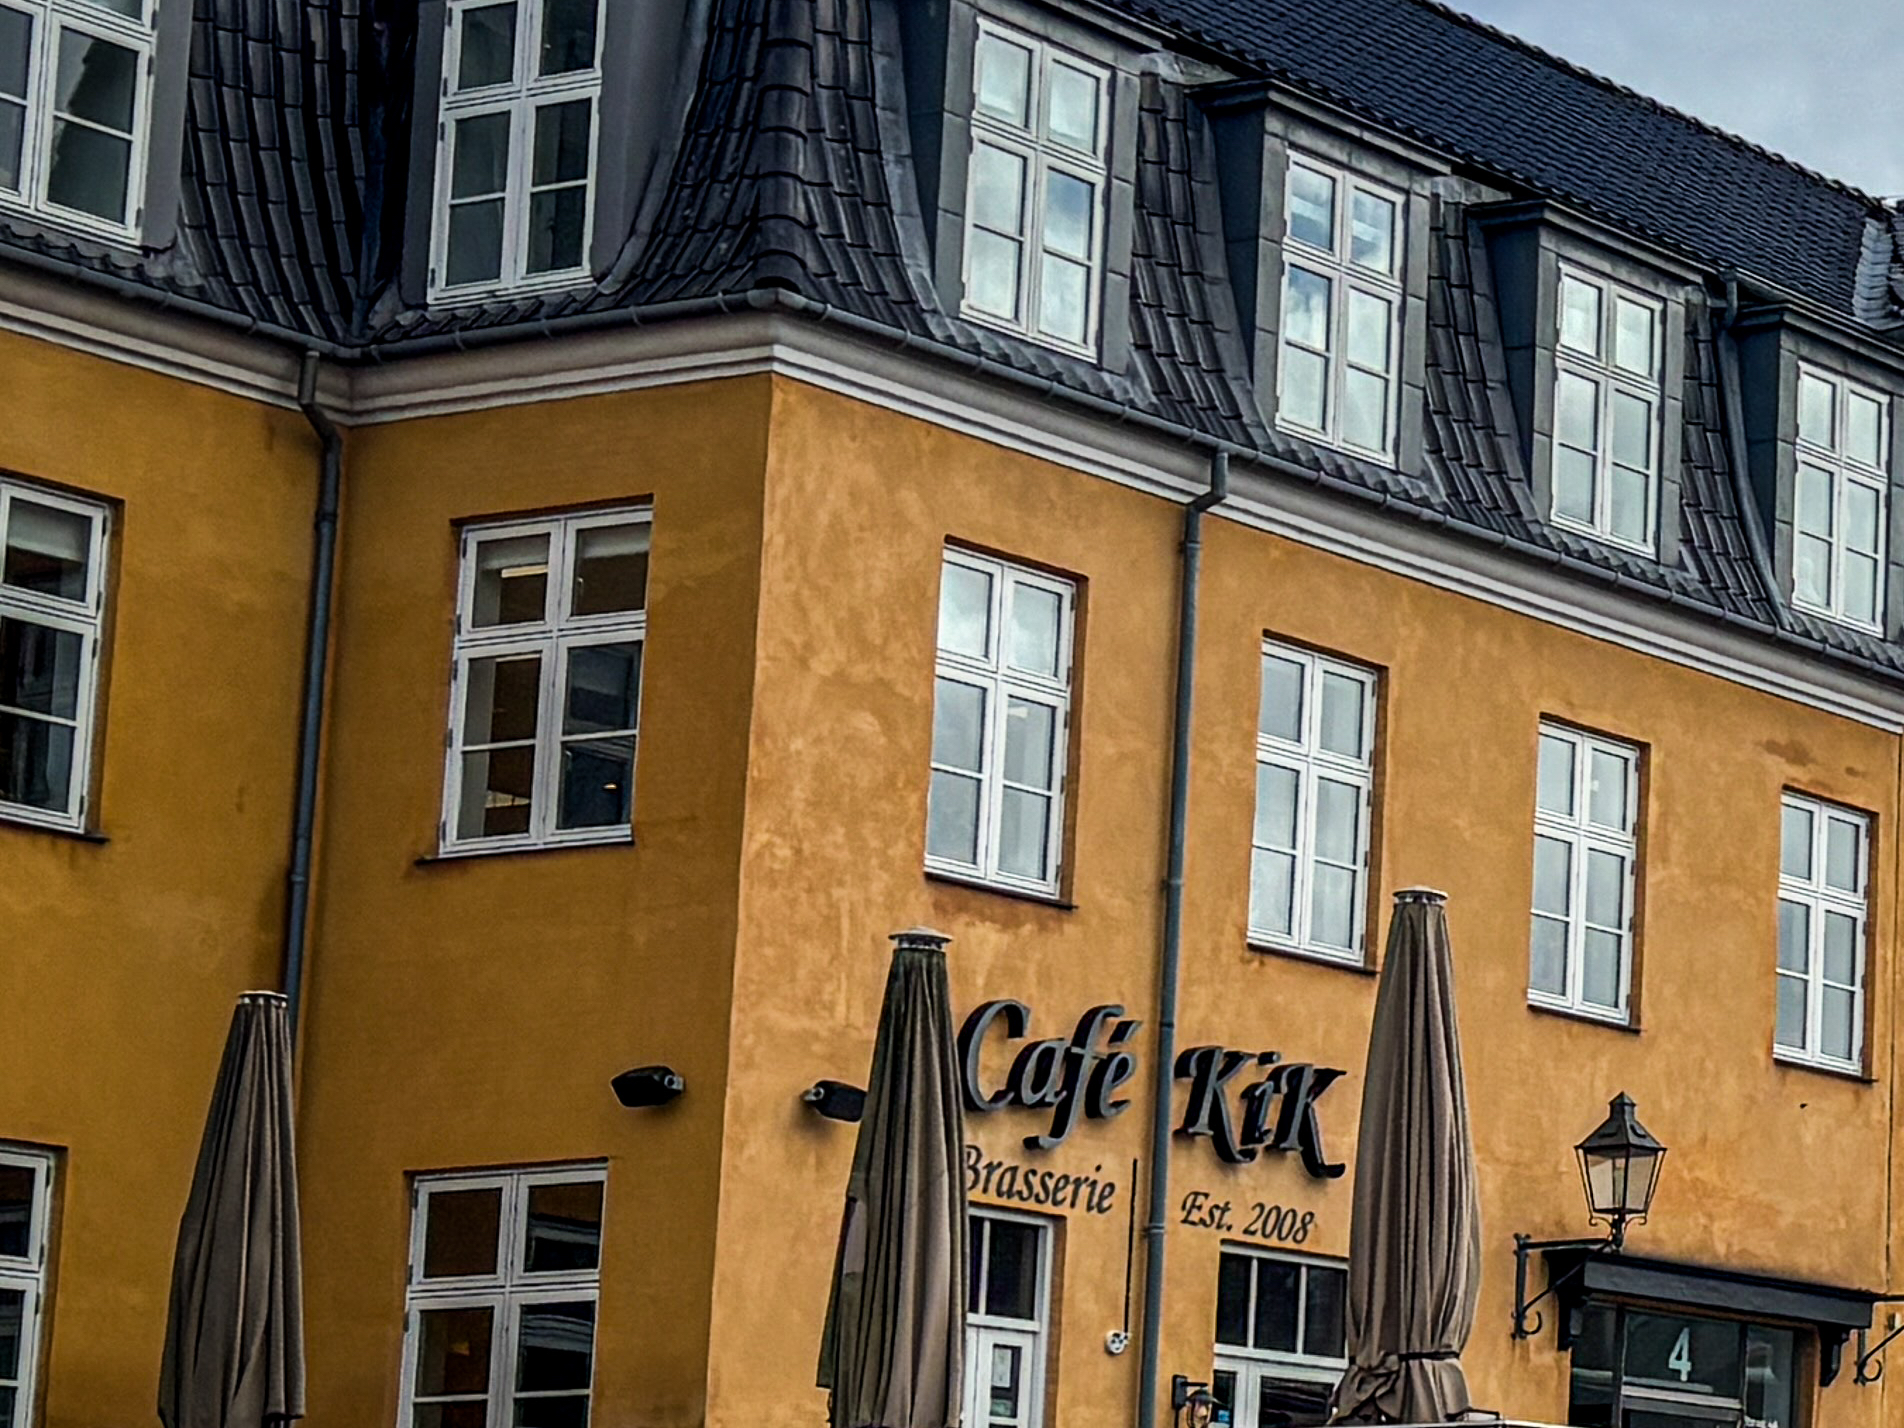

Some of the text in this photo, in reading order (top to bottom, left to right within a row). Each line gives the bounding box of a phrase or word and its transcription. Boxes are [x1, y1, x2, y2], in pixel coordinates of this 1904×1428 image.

[957, 999, 1347, 1179] Café KiK
[965, 1144, 1115, 1214] Brasserie
[1181, 1190, 1315, 1245] Est. 2008
[1668, 1327, 1692, 1382] 4
